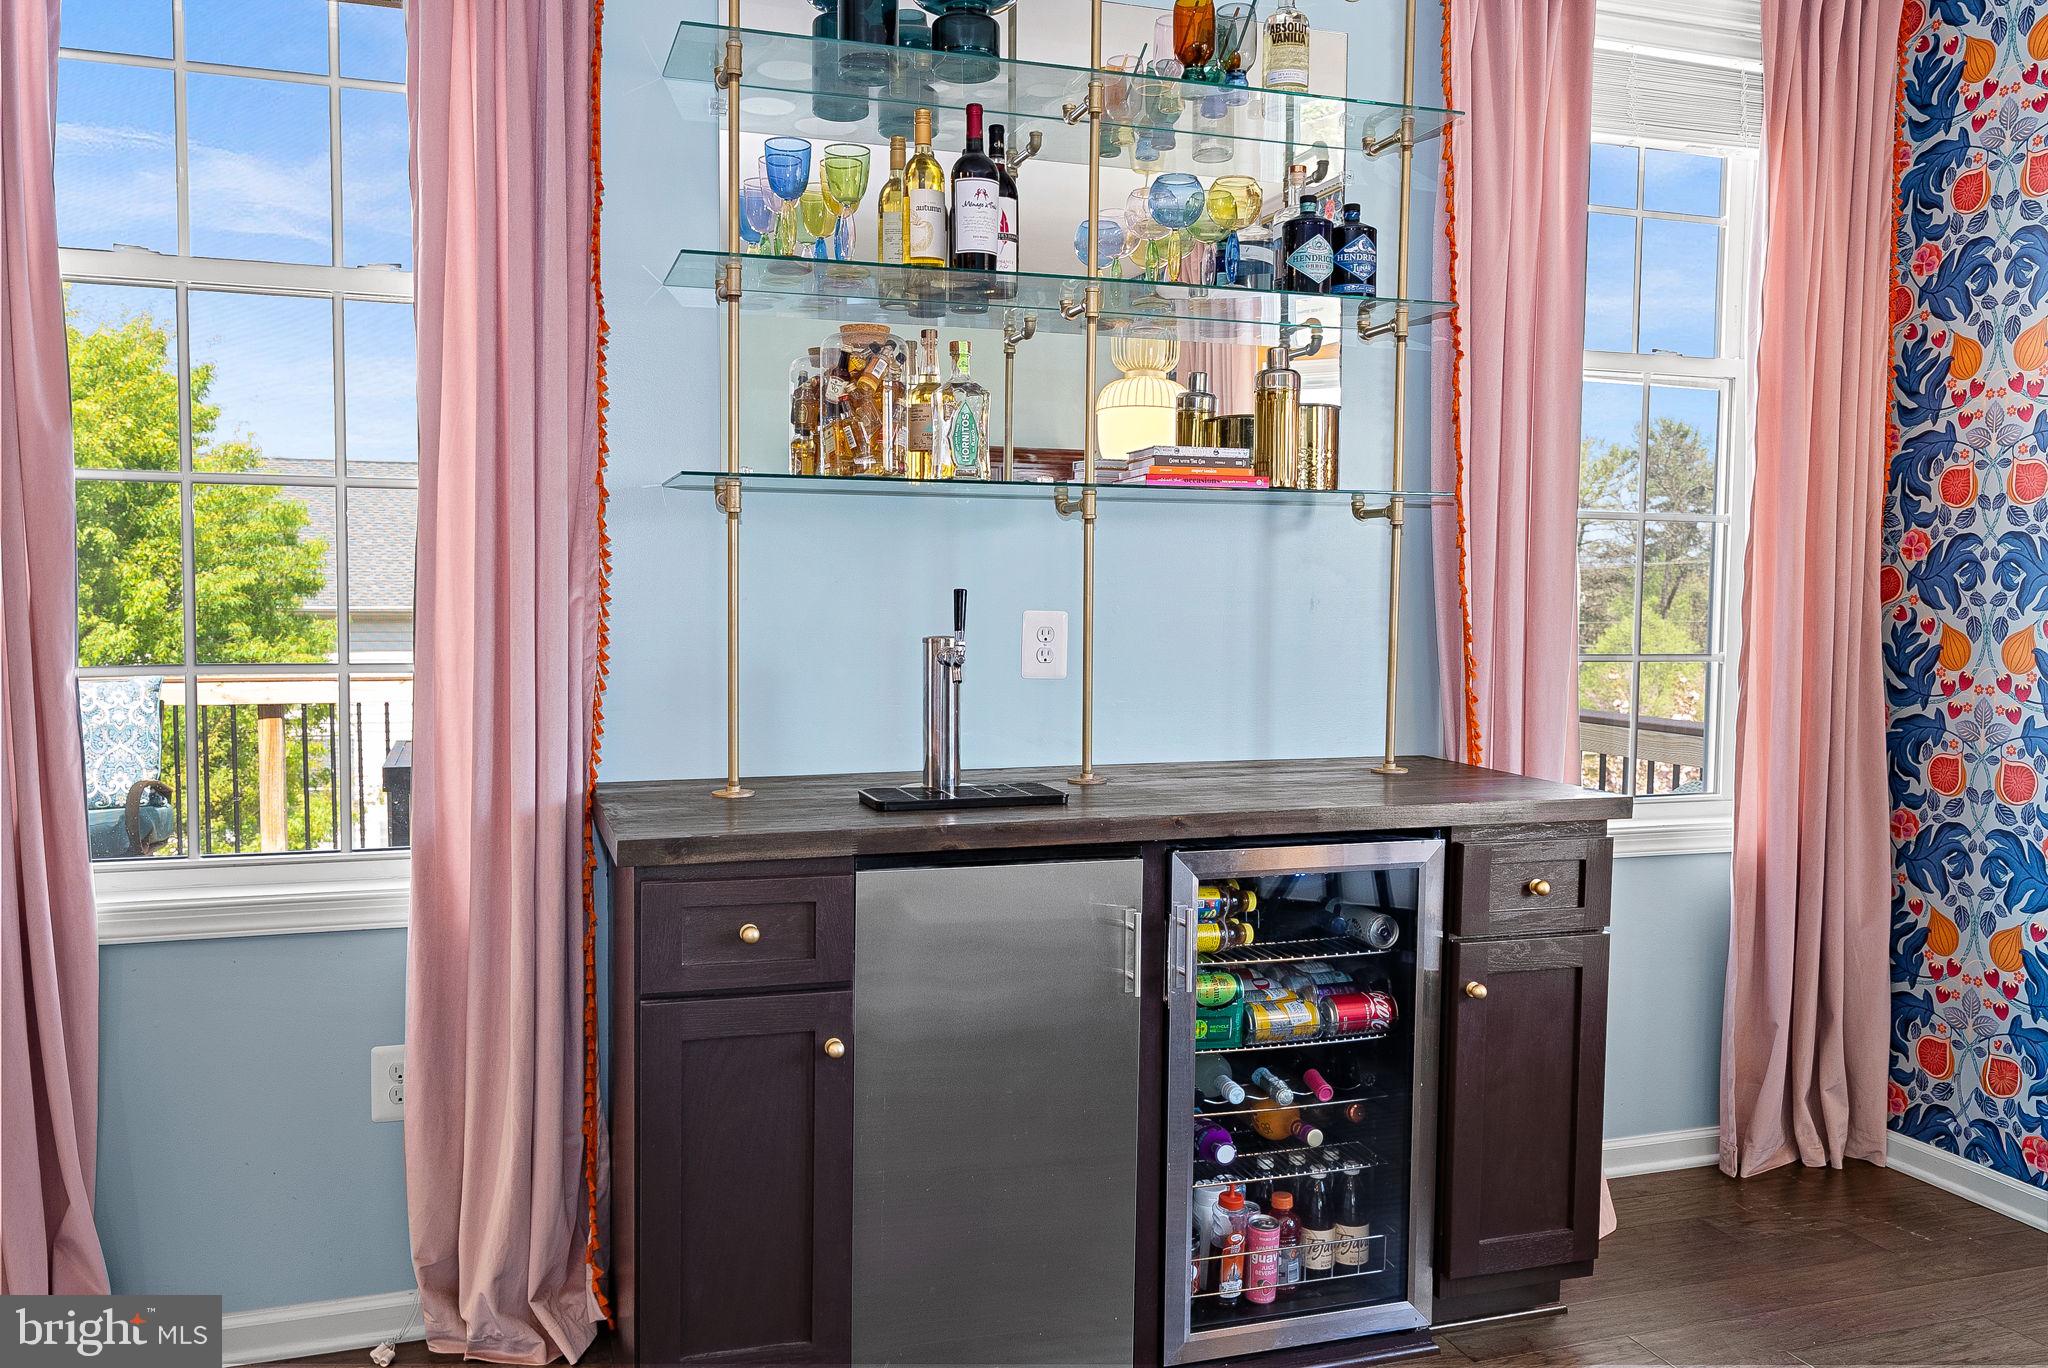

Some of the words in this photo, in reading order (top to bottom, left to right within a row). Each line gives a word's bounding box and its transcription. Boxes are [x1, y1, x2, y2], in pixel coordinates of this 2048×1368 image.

[1269, 21, 1308, 36] ABSOLUT
[1271, 33, 1306, 46] VANILIA
[915, 204, 942, 214] autumn
[961, 412, 970, 463] HORNITOS
[1251, 1253, 1278, 1264] guav
